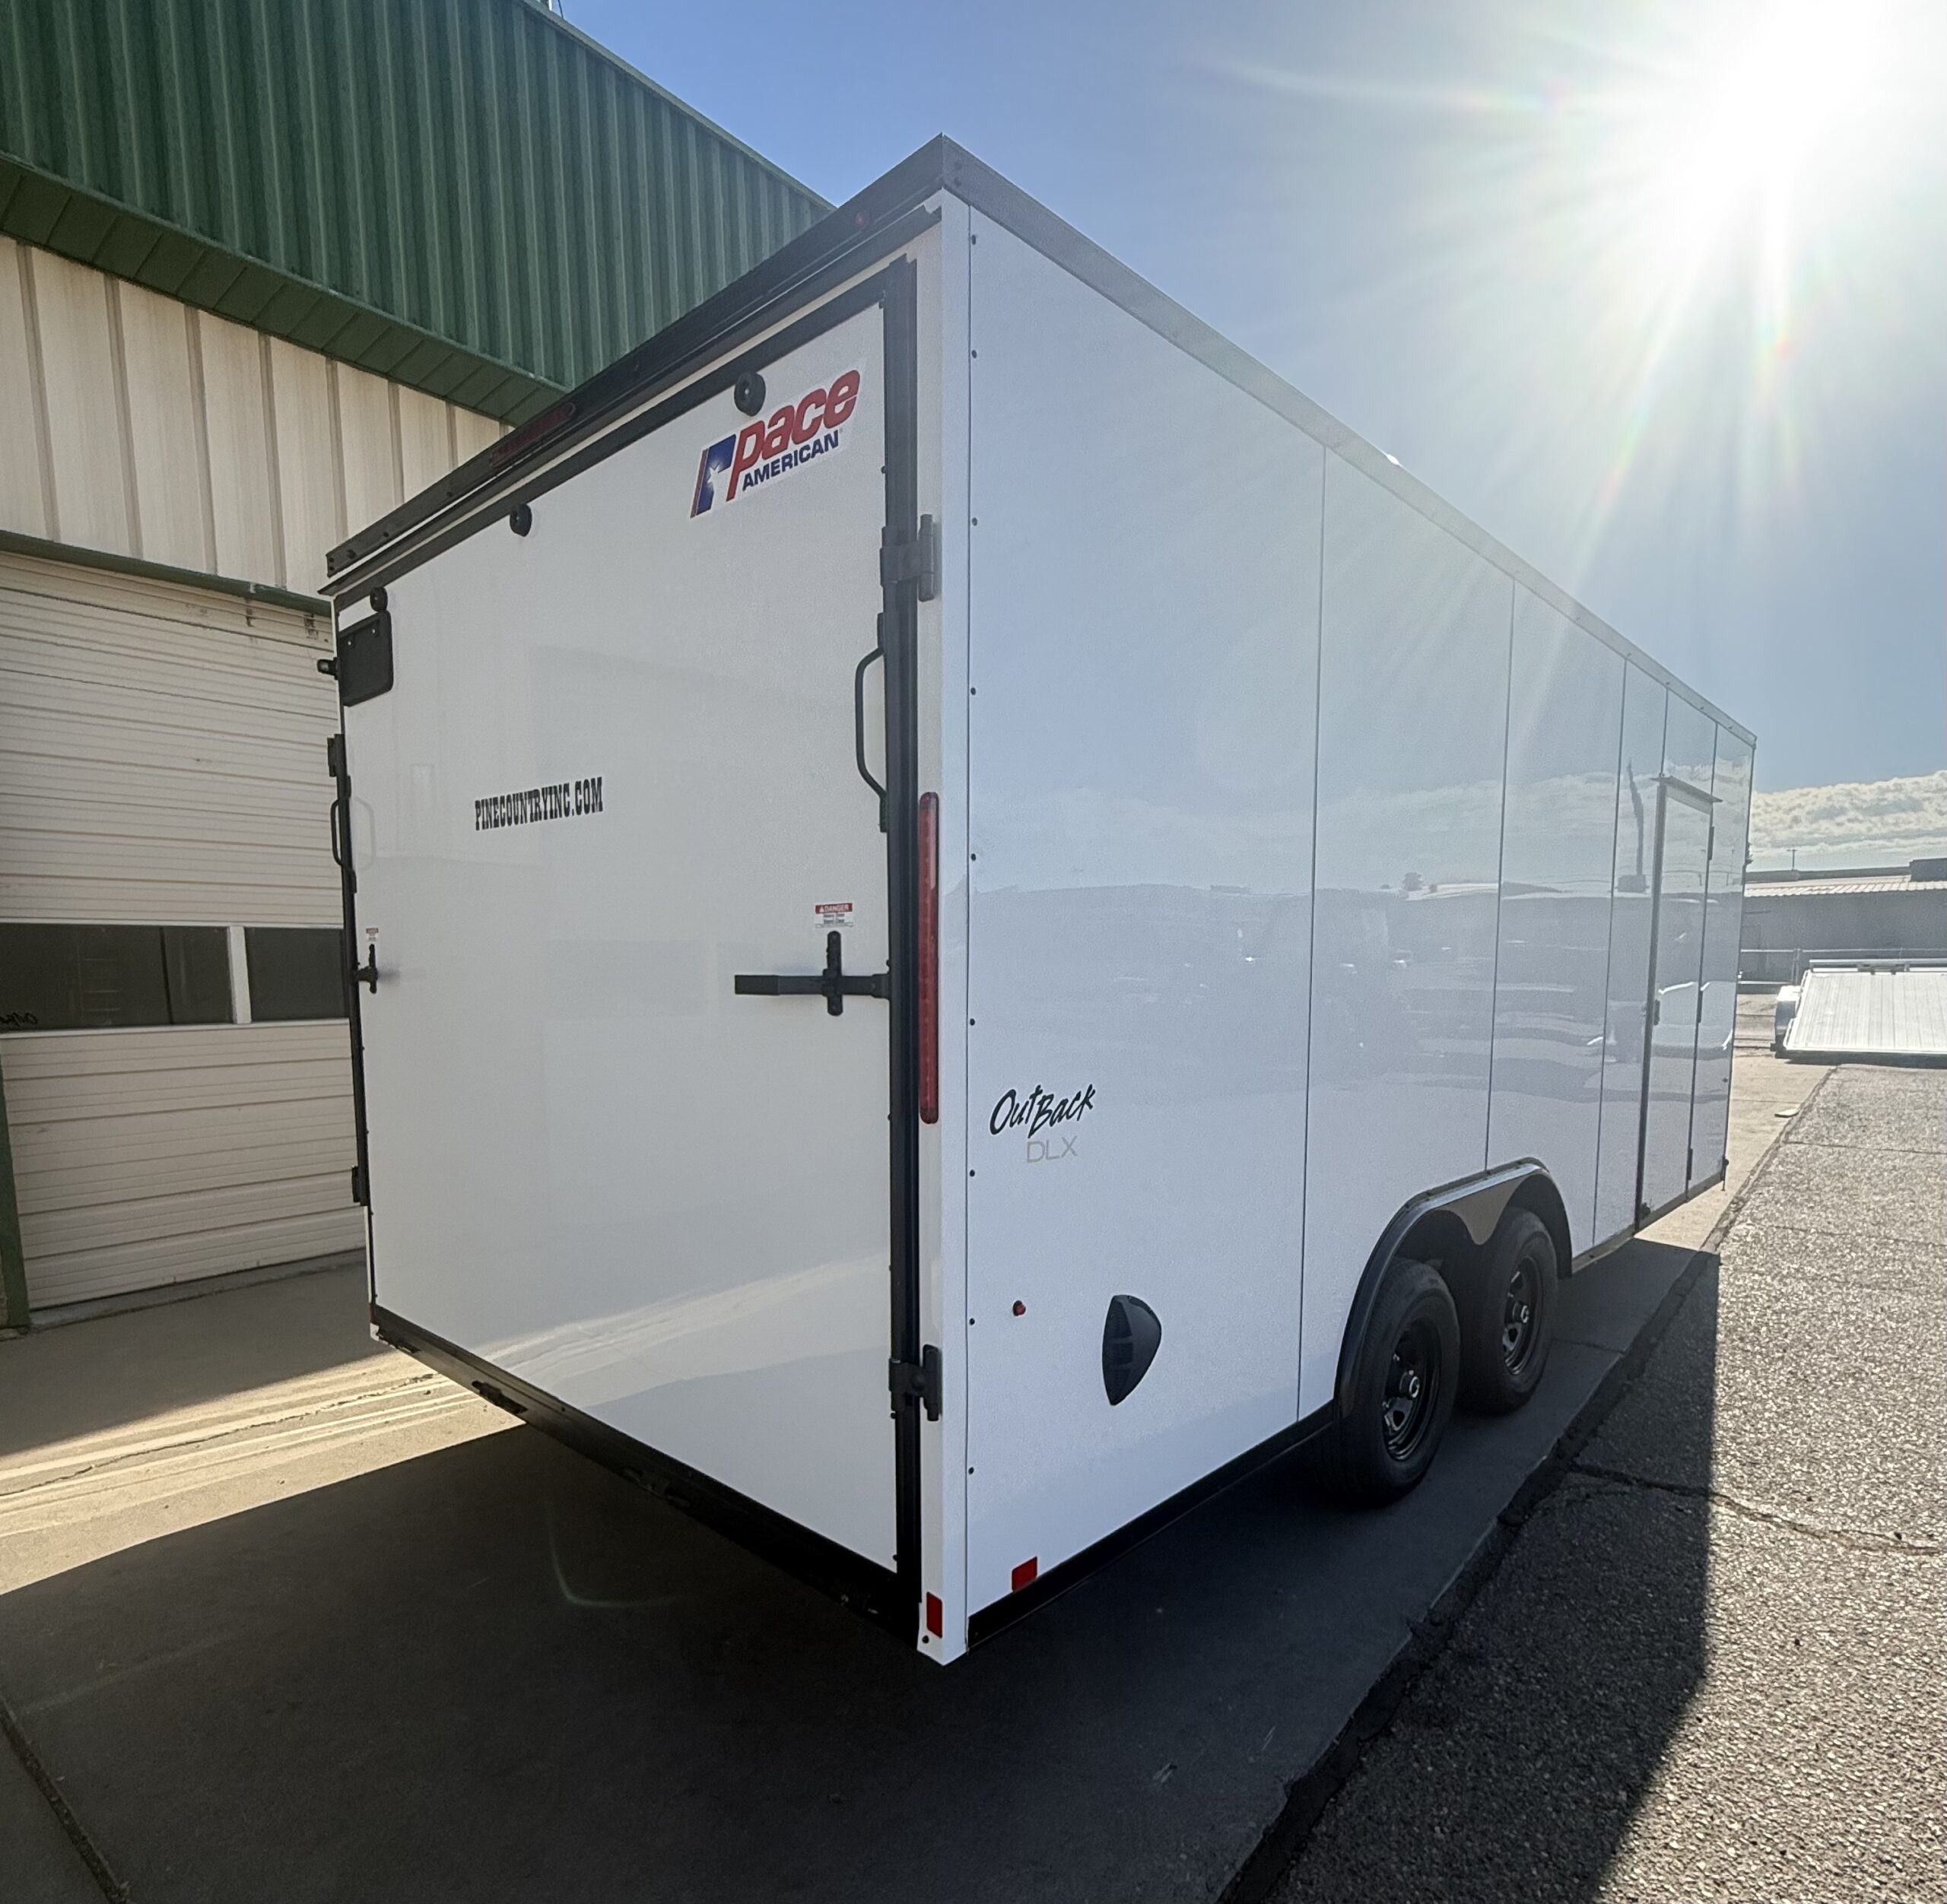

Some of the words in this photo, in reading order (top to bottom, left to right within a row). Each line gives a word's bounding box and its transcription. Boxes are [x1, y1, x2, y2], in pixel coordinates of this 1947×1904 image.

[726, 370, 860, 502] pace
[742, 430, 839, 491] AMERICAN
[475, 776, 603, 831] PINECOUNTRYINC.COM
[989, 1084, 1096, 1139] OutBack
[1027, 1135, 1078, 1163] DLX
